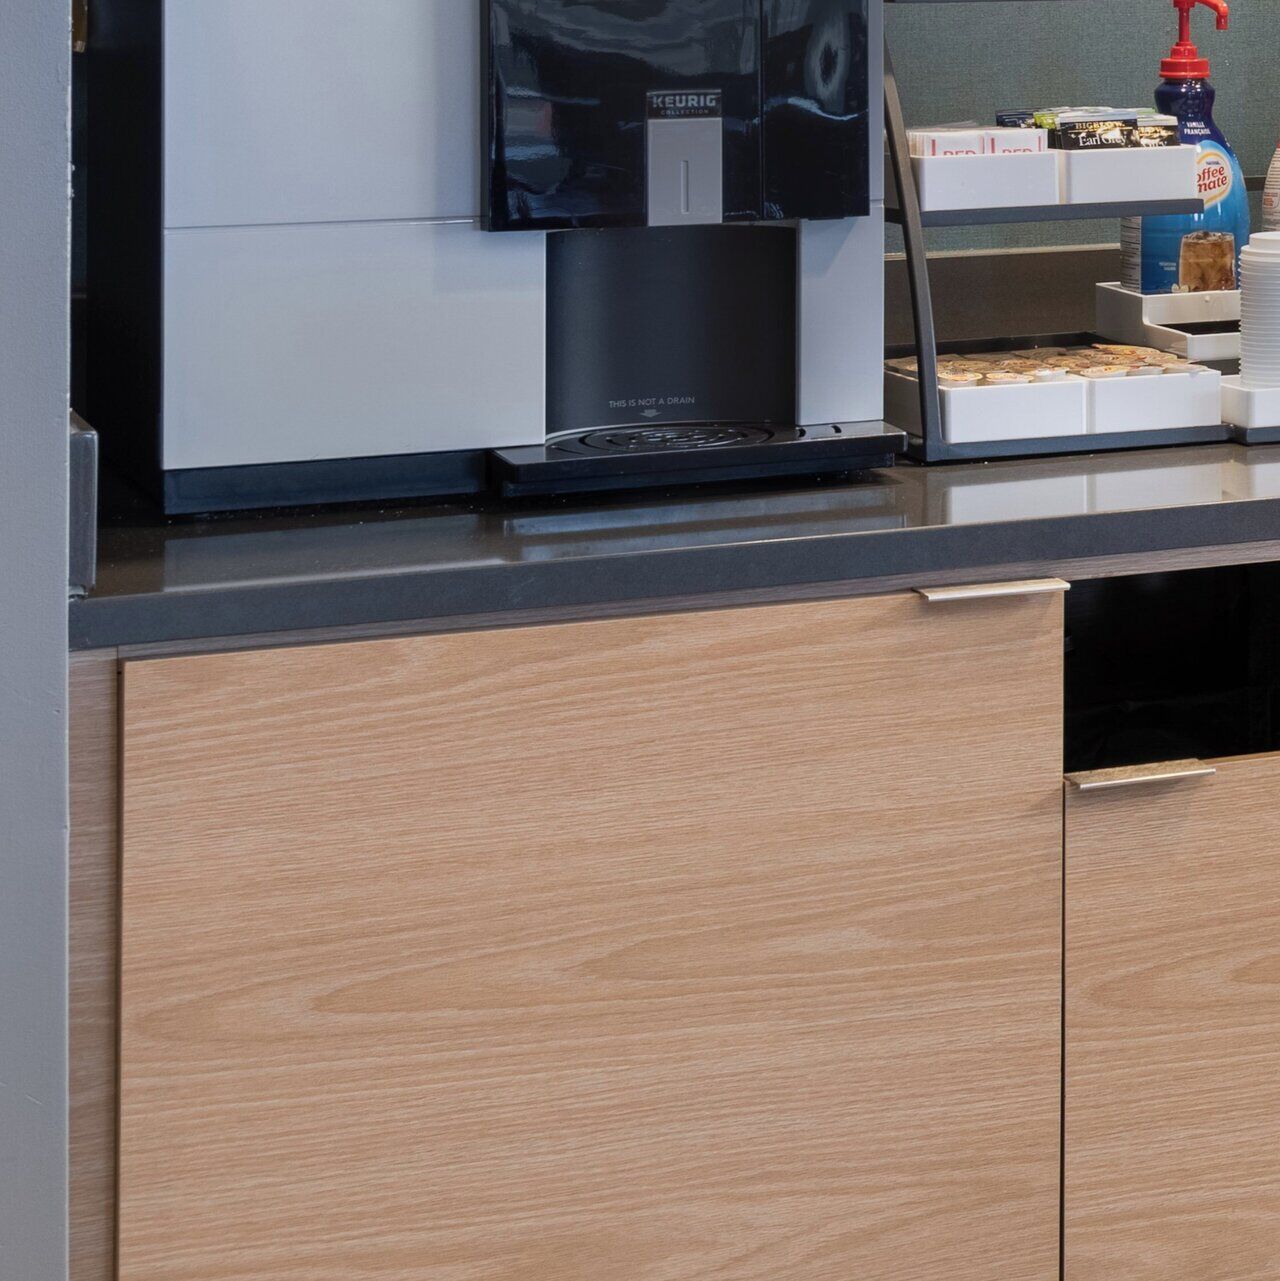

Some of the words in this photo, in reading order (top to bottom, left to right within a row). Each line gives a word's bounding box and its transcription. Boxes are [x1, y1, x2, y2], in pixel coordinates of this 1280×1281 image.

[652, 95, 716, 108] KEURIG
[1079, 132, 1101, 147] Earl
[609, 400, 627, 408] THIS
[628, 399, 636, 407] IS
[638, 398, 656, 406] NOT
[667, 396, 695, 405] DRAIN
